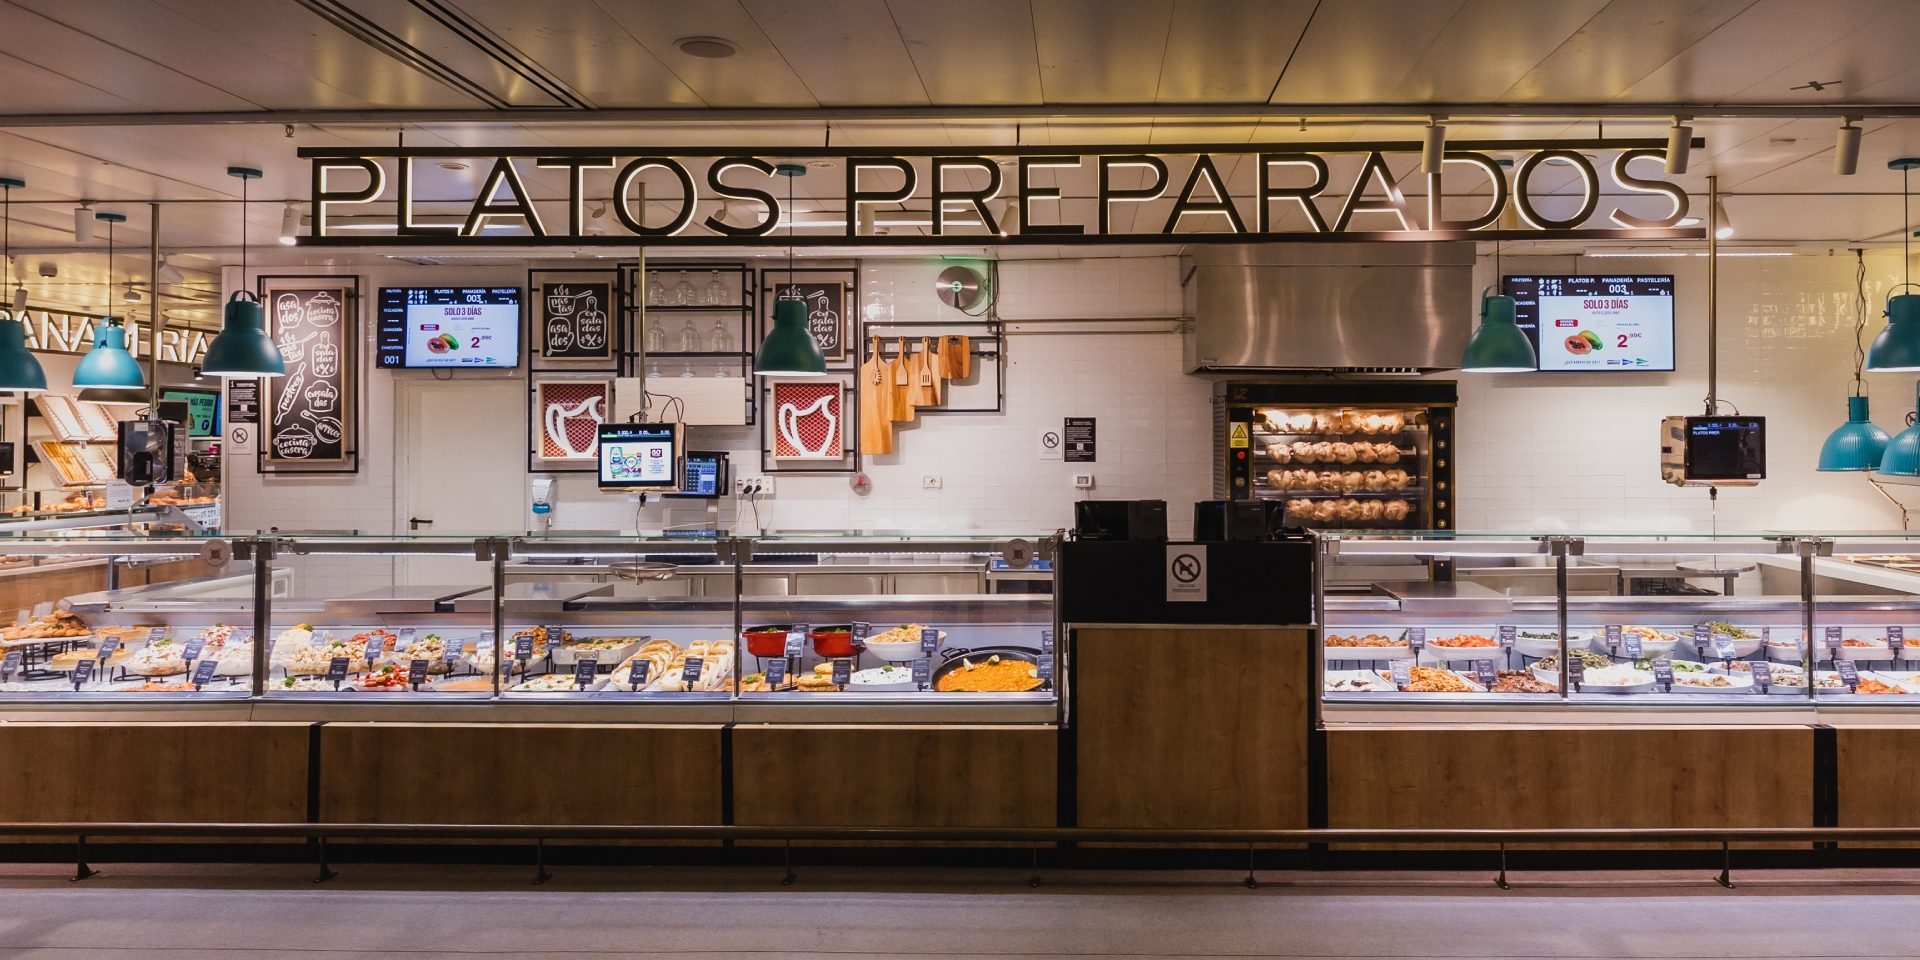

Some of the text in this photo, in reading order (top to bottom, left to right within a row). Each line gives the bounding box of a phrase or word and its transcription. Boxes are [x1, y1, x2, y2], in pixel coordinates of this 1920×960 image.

[312, 149, 1690, 236] PLATOS PREPARADOS
[1608, 285, 1627, 293] 003
[280, 300, 297, 311] asa
[551, 297, 568, 308] pas
[1583, 298, 1628, 309] SOLO 3 DÍAS
[309, 307, 335, 315] cocina
[444, 306, 482, 316] SOLO 3 DÍAS
[282, 311, 299, 323] dos
[580, 317, 603, 325] sala
[812, 317, 835, 325] sala
[550, 325, 568, 333] asa
[551, 334, 568, 346] dos
[384, 356, 399, 364] 001
[280, 376, 301, 411] postres
[307, 388, 334, 398] ensala
[314, 397, 328, 407] das
[317, 422, 341, 438] arroces
[280, 438, 310, 448] cocina
[280, 446, 308, 455] casera
